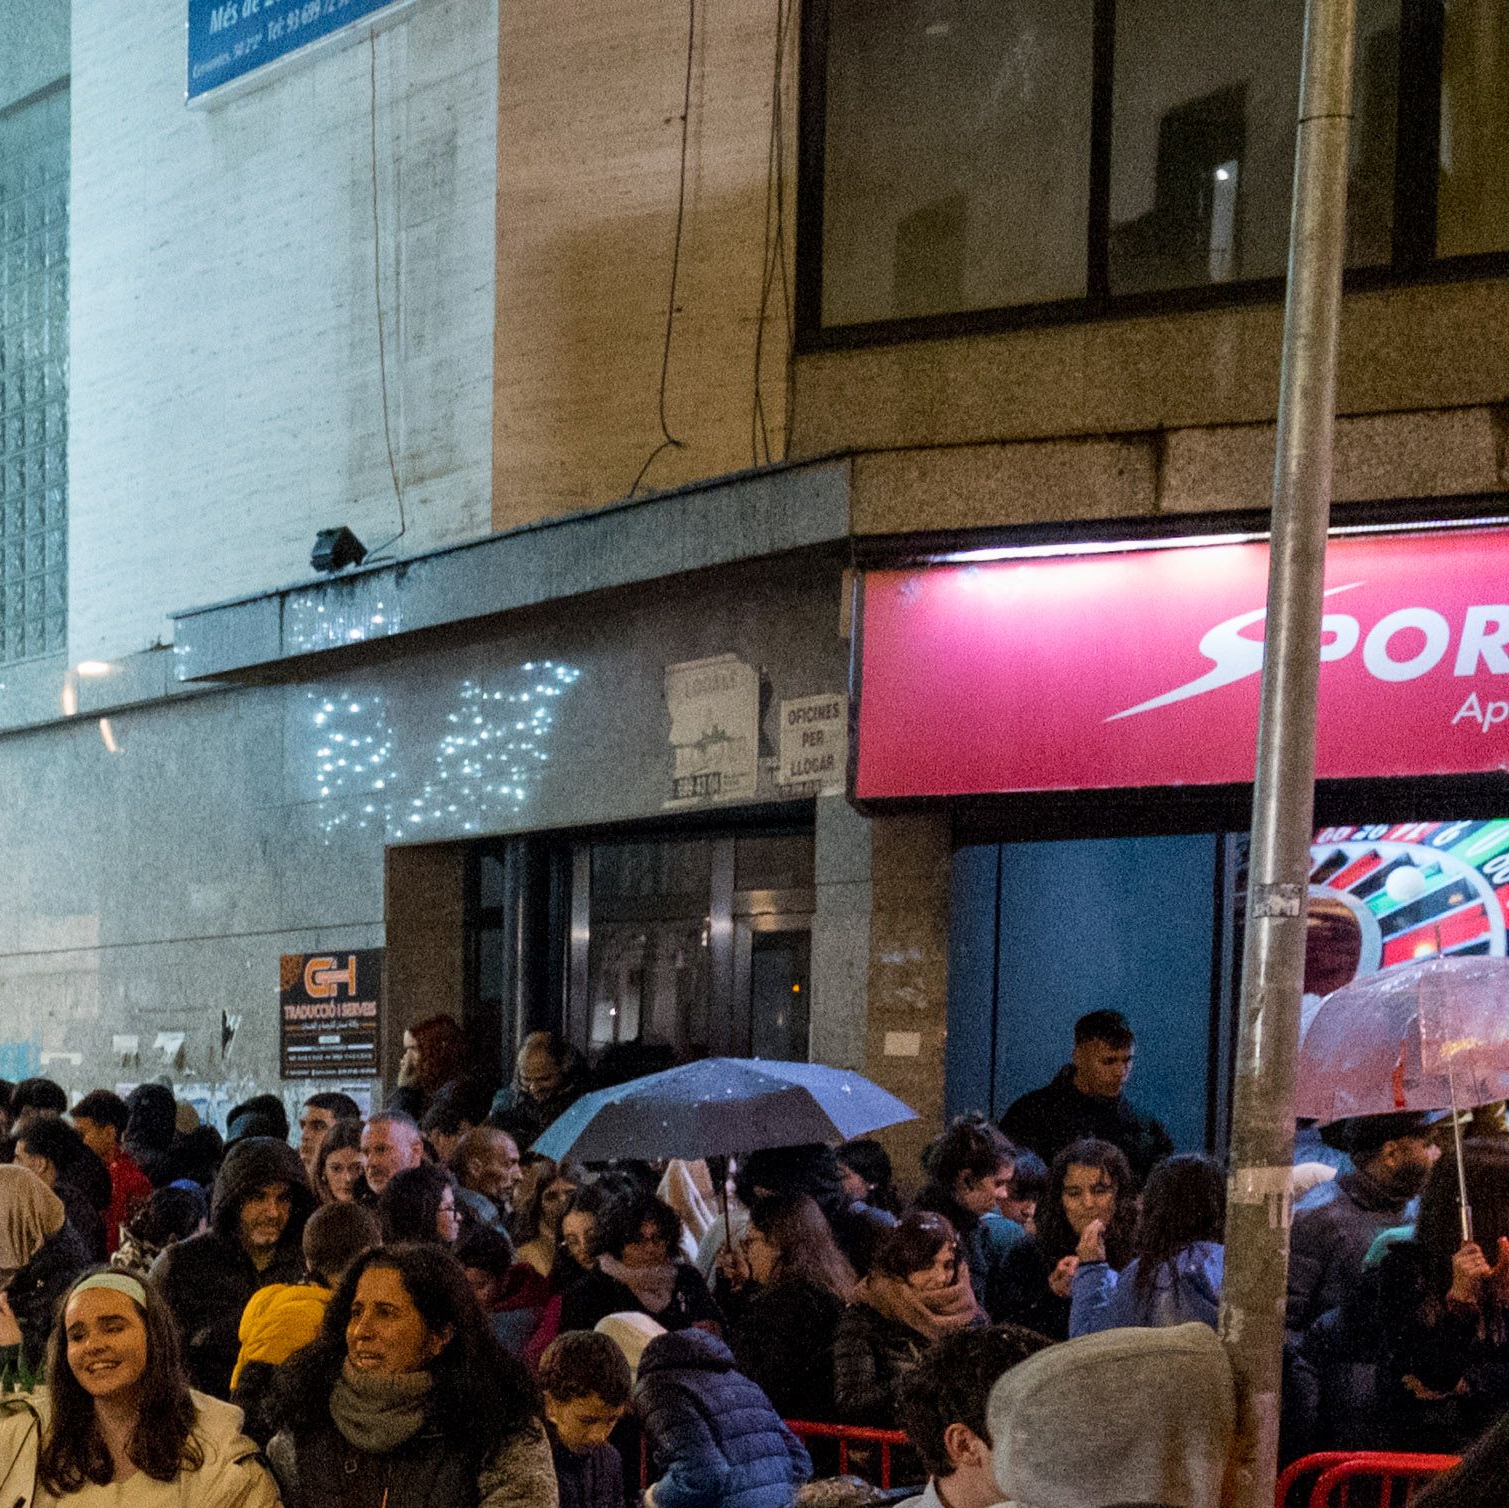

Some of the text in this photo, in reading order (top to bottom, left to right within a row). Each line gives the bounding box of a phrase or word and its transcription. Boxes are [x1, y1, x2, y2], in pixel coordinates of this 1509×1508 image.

[787, 702, 840, 725] OFICINES
[1451, 692, 1509, 733] Ap
[802, 730, 824, 748] PER
[789, 754, 835, 777] LLOGAR
[284, 999, 336, 1020] TRADUCCIÓ
